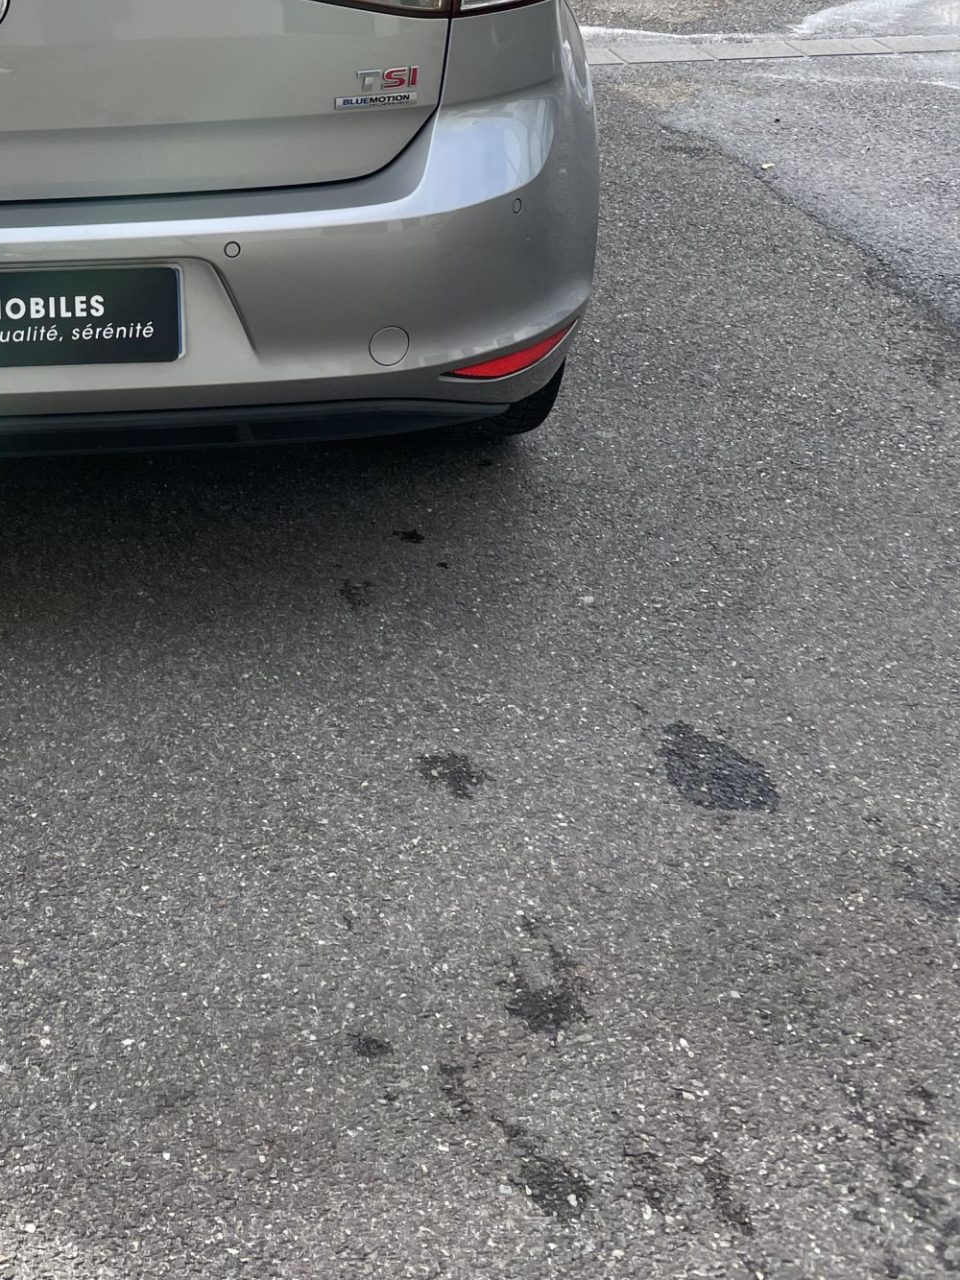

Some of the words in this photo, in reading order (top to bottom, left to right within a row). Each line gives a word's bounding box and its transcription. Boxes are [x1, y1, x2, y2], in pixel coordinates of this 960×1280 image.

[356, 66, 419, 92] TSI
[342, 94, 410, 106] BLUEMOTION
[71, 322, 155, 341] sérénité
